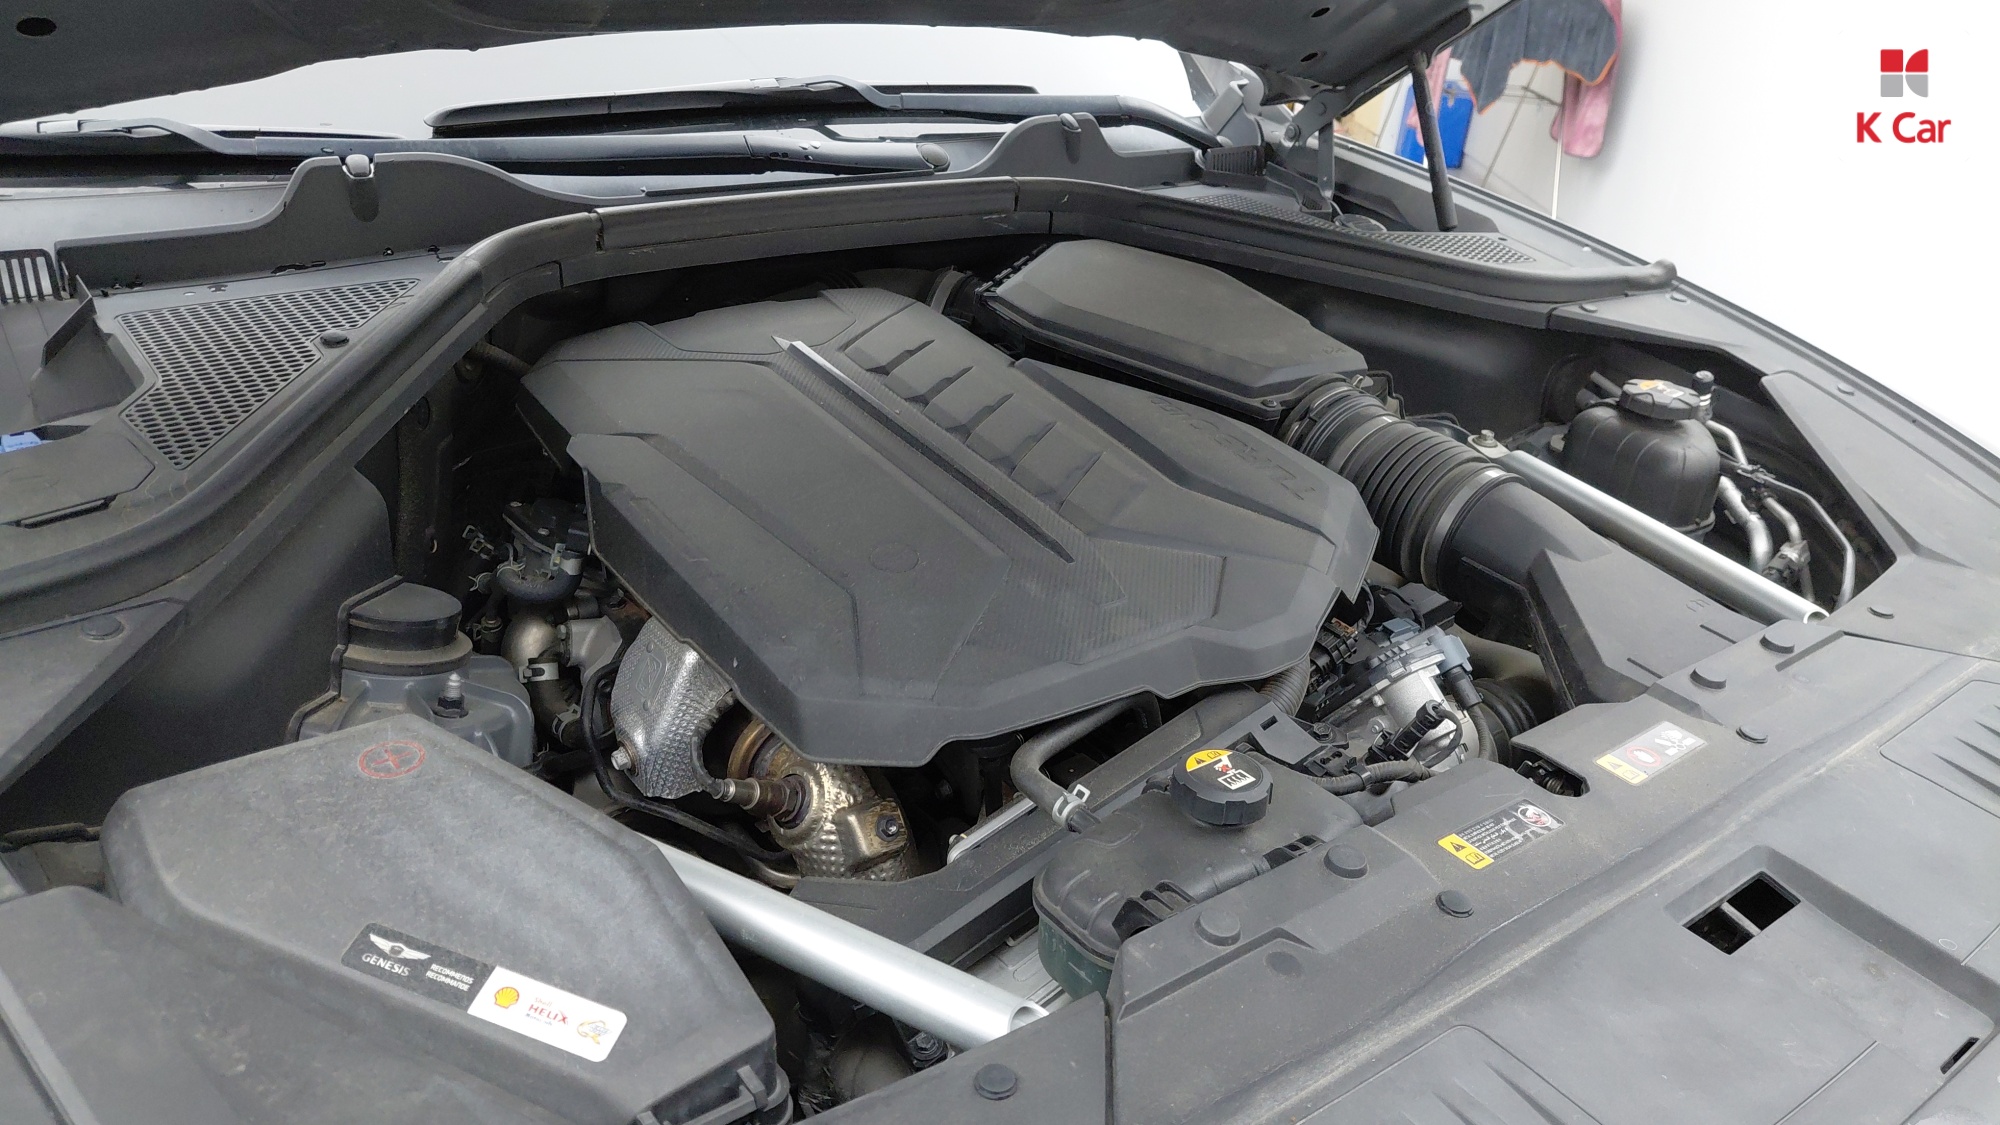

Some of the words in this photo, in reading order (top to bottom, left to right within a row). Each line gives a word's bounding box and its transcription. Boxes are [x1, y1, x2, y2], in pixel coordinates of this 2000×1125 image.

[361, 952, 411, 977] GENESIS
[430, 963, 475, 985] RECOMMENDS
[425, 970, 471, 992] RECOMMANDE
[528, 1003, 569, 1026] HELIX
